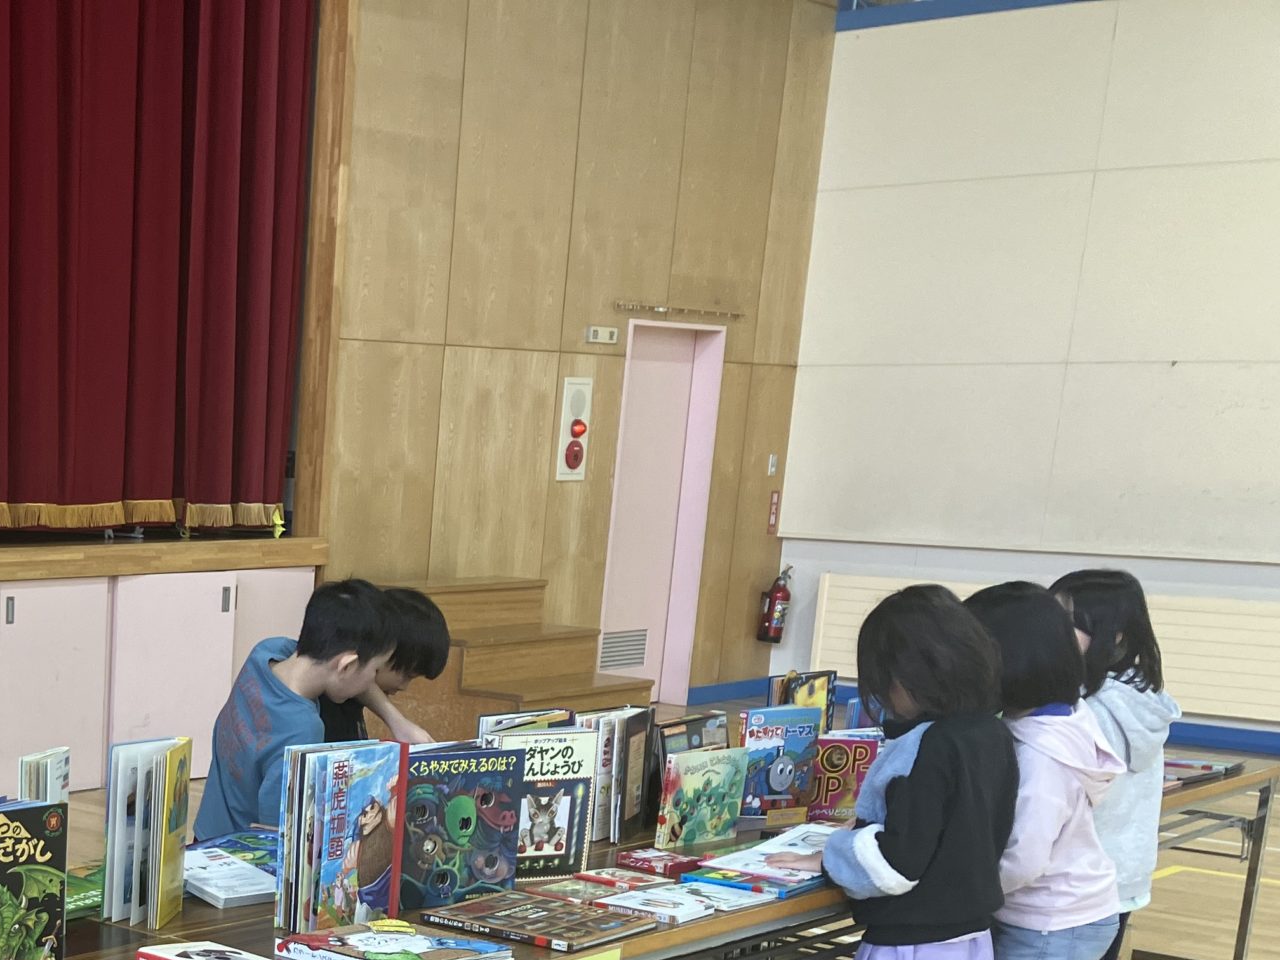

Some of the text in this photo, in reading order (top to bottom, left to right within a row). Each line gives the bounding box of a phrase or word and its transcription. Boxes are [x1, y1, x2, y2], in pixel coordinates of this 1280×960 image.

[784, 724, 814, 738] トーマス
[525, 746, 574, 761] ダヤンの
[818, 743, 870, 775] OP-
[409, 756, 517, 777] くらやみでみえるのは?
